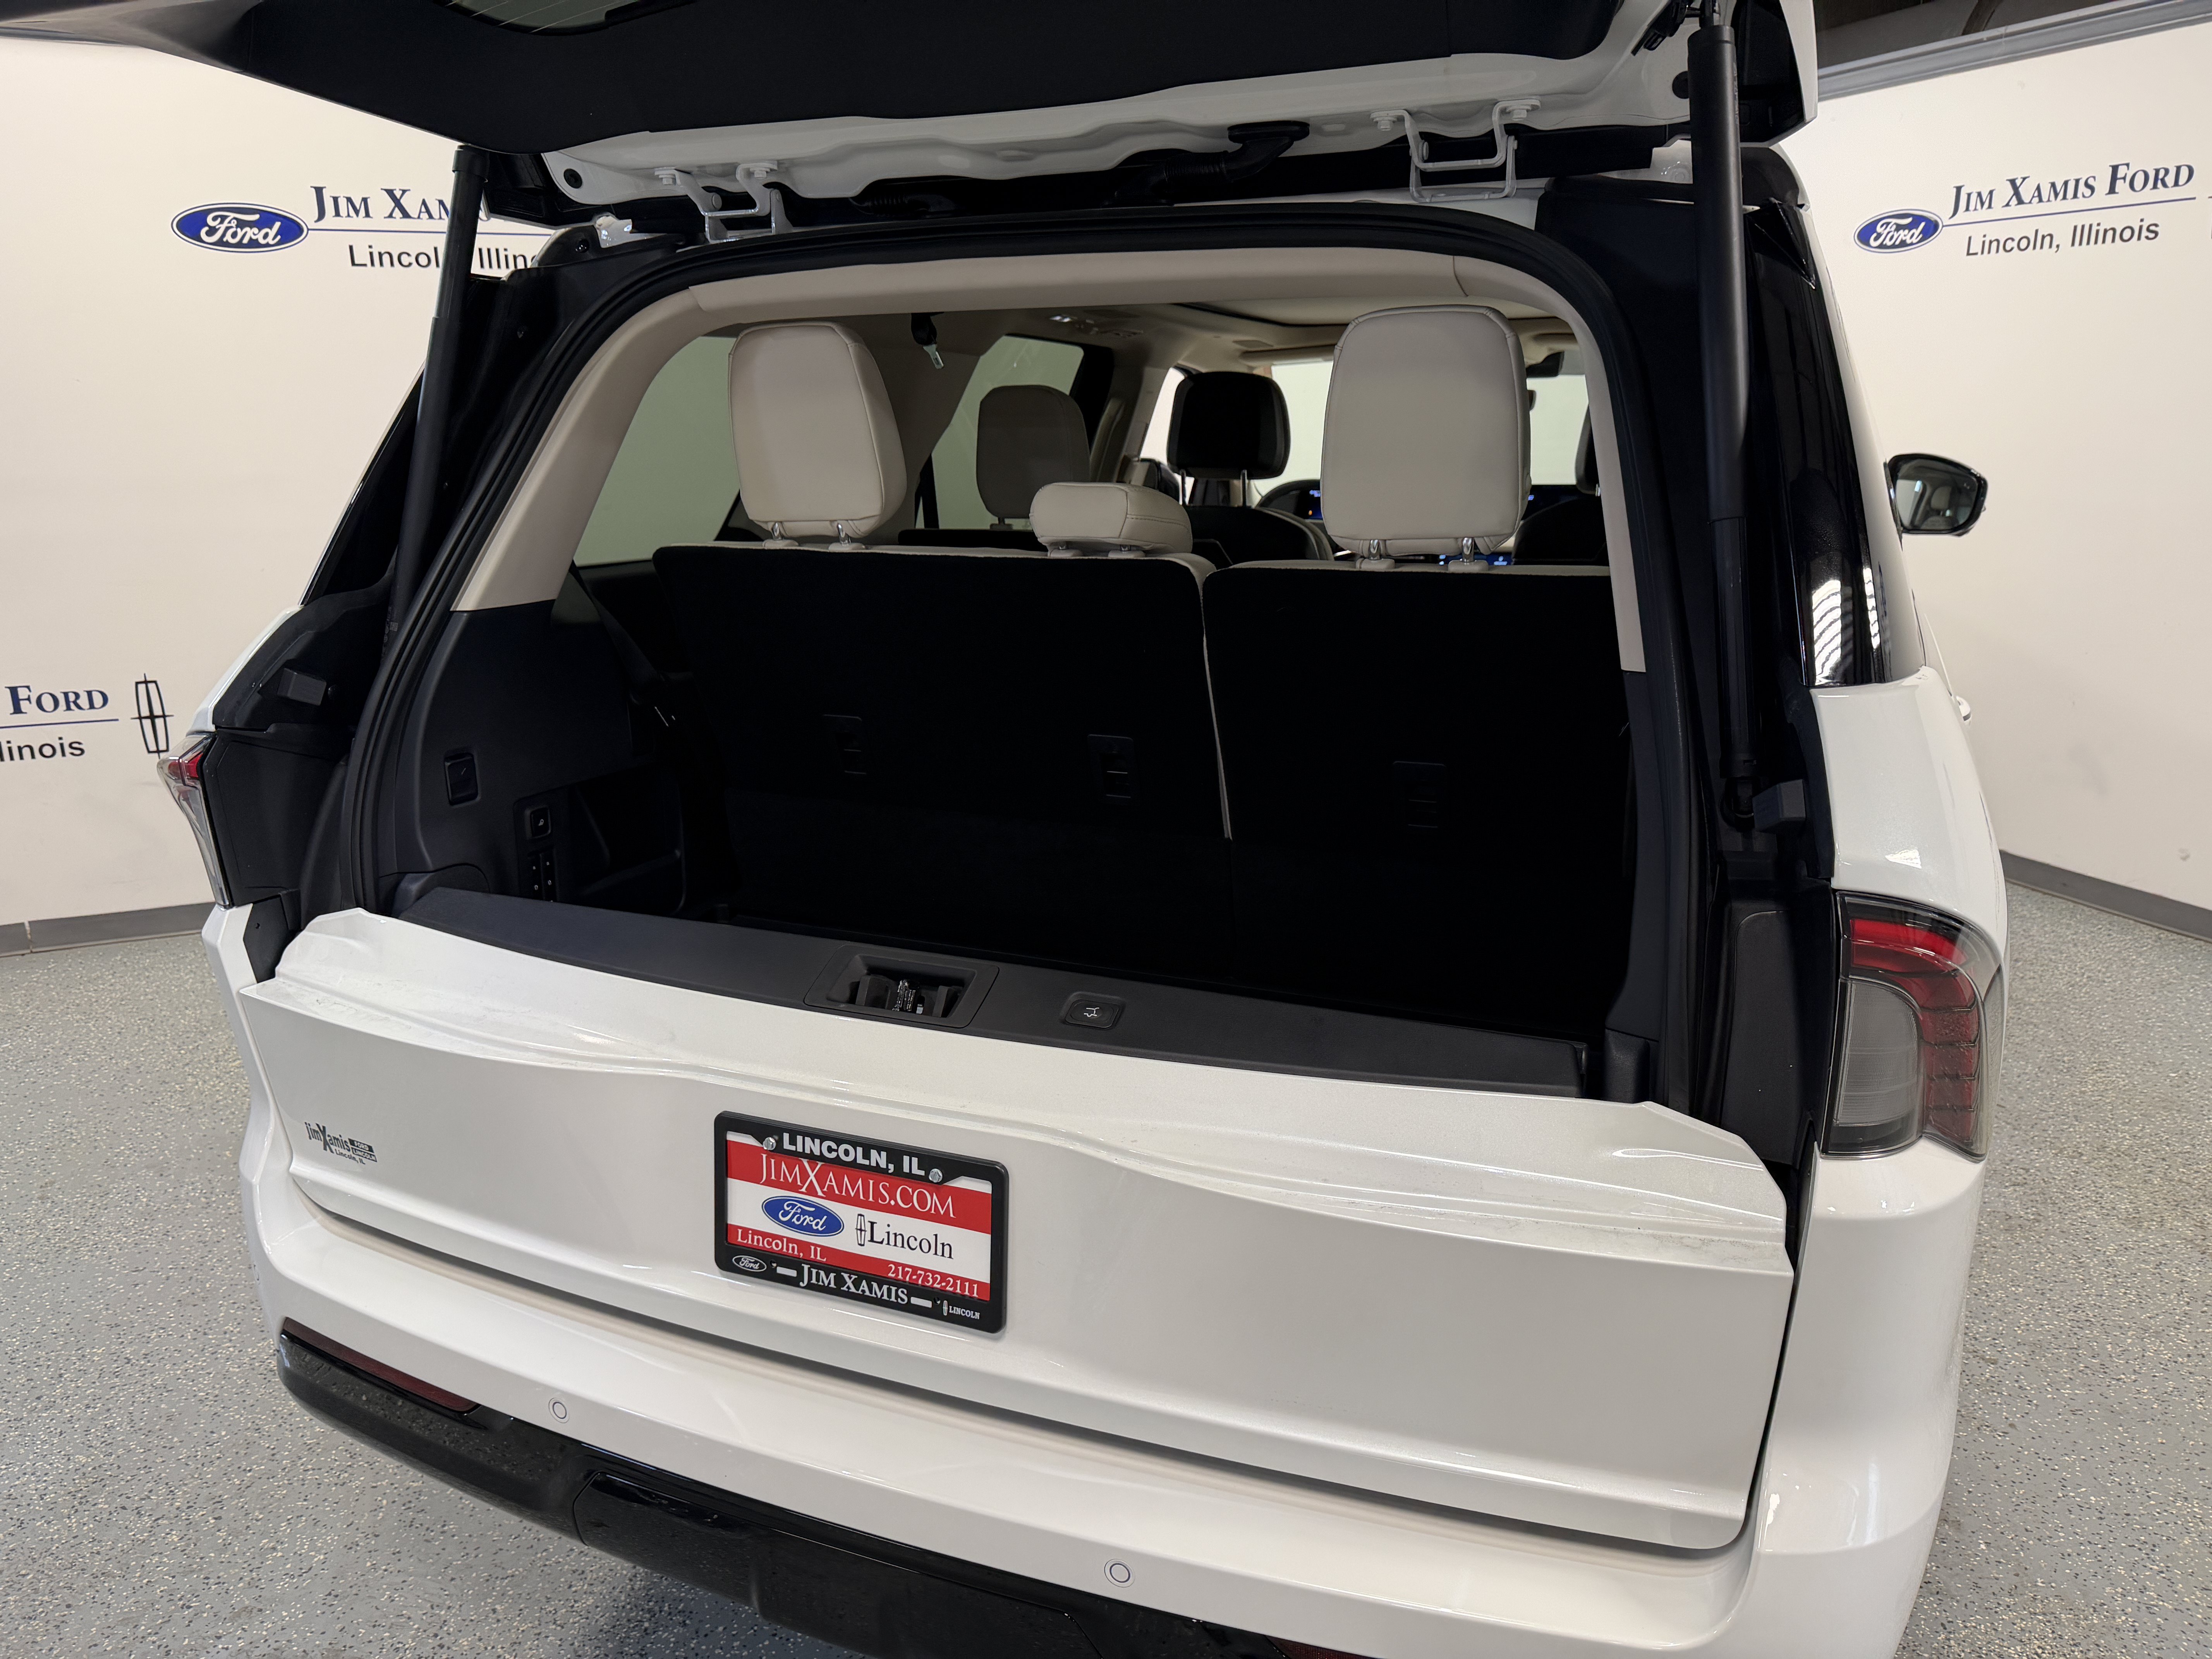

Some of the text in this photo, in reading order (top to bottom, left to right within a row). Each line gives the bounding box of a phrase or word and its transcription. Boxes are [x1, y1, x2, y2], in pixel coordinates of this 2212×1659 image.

[310, 186, 373, 222] JIM
[1949, 163, 2194, 219] JIM XAMIS FORD
[201, 211, 281, 246] Ford
[1869, 218, 1926, 247] Ford
[1965, 218, 2160, 256] Lincoln, Illinois
[349, 244, 537, 269] Lincol Illin
[5, 685, 109, 715] FORD
[0, 737, 85, 762] linois
[783, 1133, 925, 1176] LINCOLN, IL
[760, 1153, 956, 1218] JIMXAMIS.COM
[778, 1200, 826, 1231] Ford
[737, 1229, 827, 1262] Lincoln, IL
[867, 1221, 954, 1259] Lincoln
[739, 1257, 759, 1269] Ford
[800, 1264, 908, 1304] JIM XAMIS
[888, 1264, 979, 1297] 217-732-2111
[949, 1305, 980, 1320] LINCOLN
